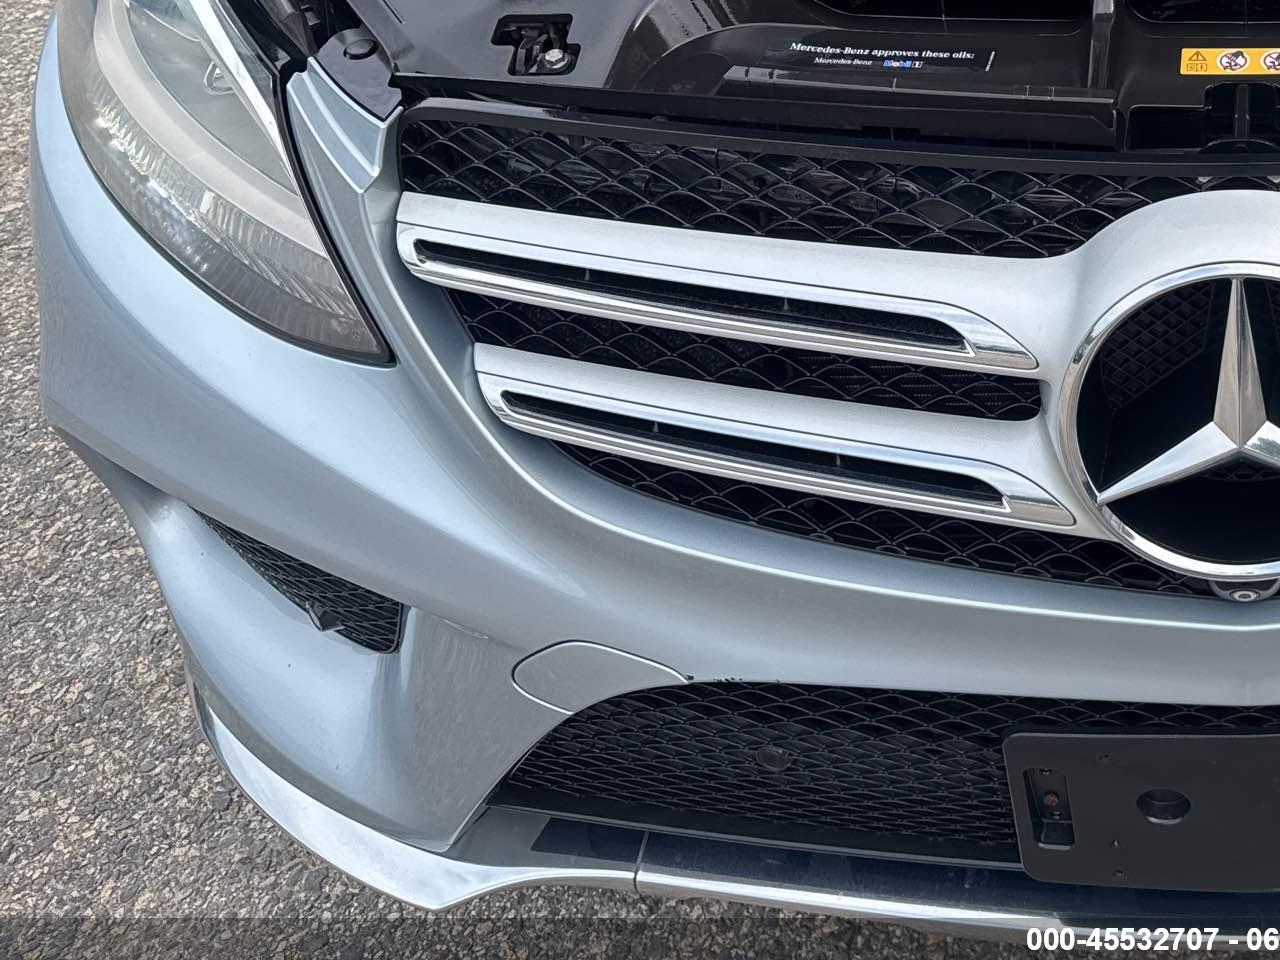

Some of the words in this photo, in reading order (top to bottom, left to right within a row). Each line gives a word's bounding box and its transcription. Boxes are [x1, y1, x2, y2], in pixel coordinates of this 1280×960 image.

[789, 42, 869, 55] Mercedes-Benz
[871, 49, 920, 57] approves
[921, 49, 951, 58] these
[952, 51, 975, 59] oils:
